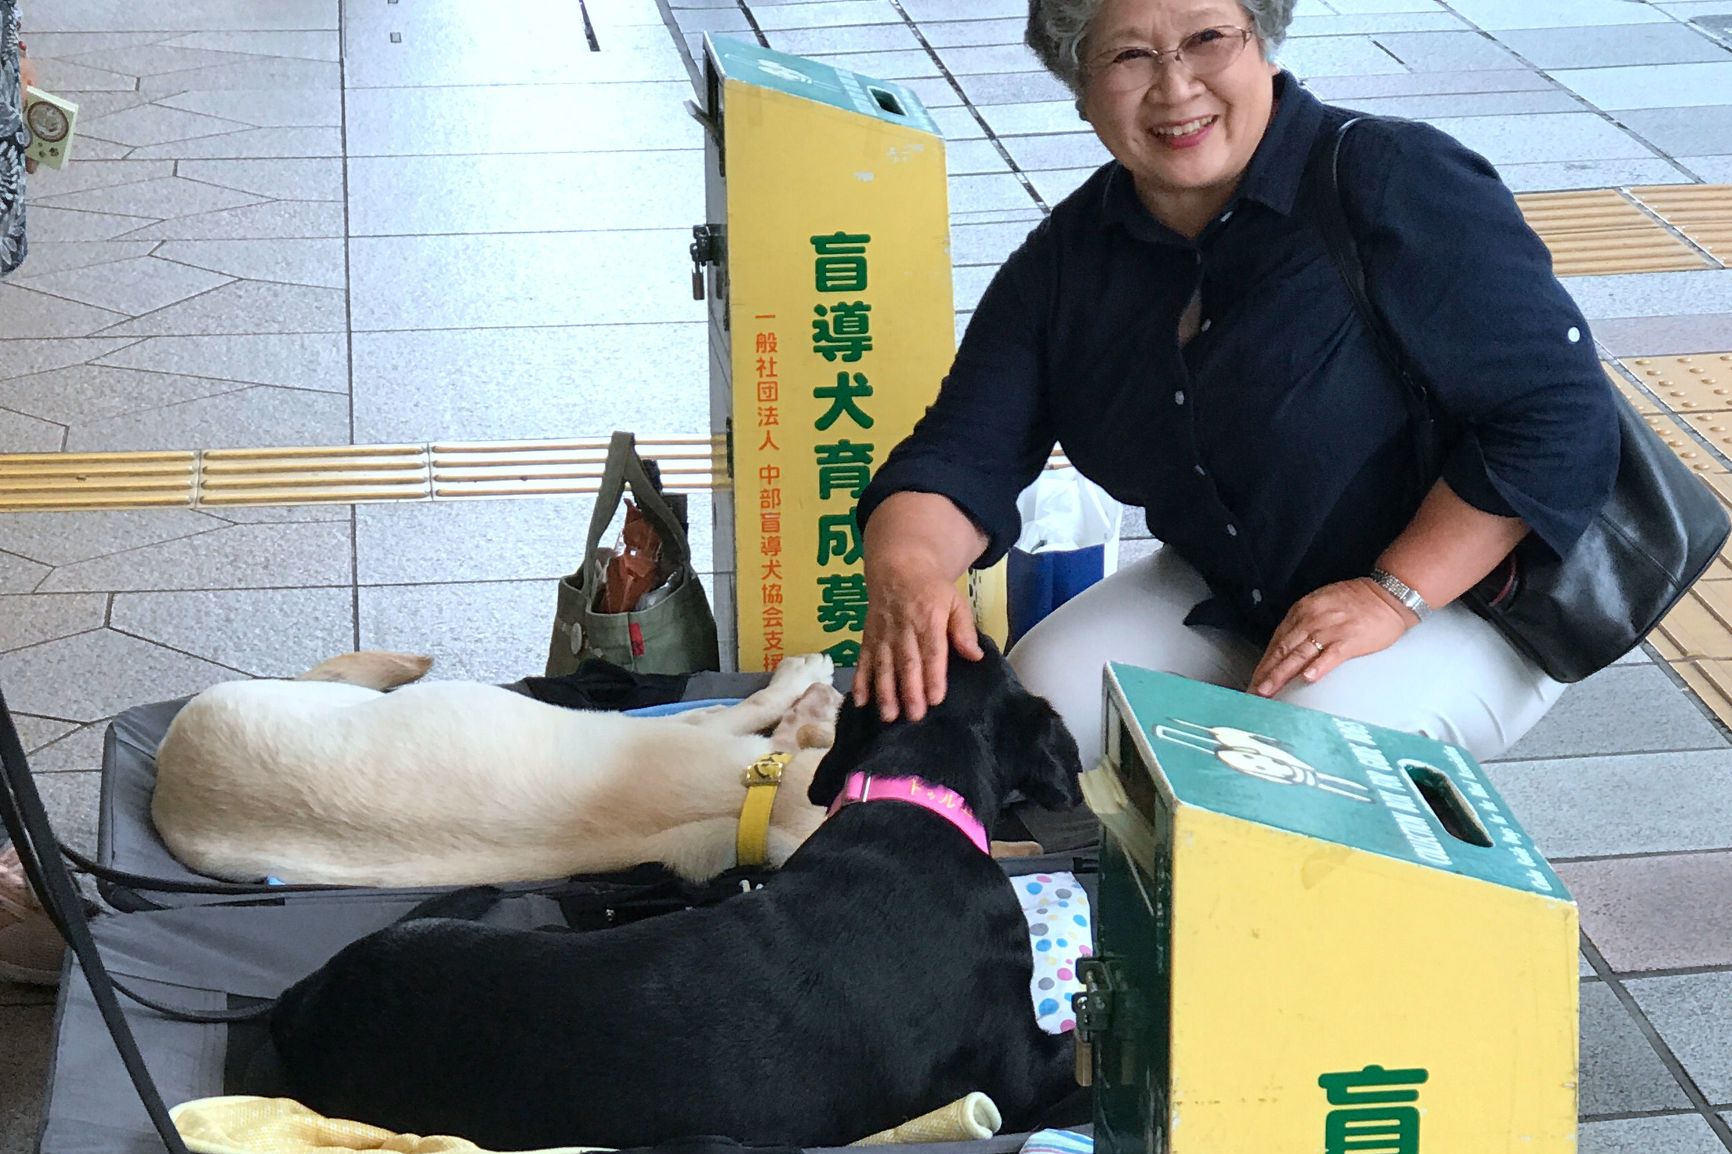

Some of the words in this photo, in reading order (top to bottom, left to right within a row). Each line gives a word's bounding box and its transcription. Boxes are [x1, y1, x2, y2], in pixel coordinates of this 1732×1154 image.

[755, 313, 780, 451] 一般社団法人
